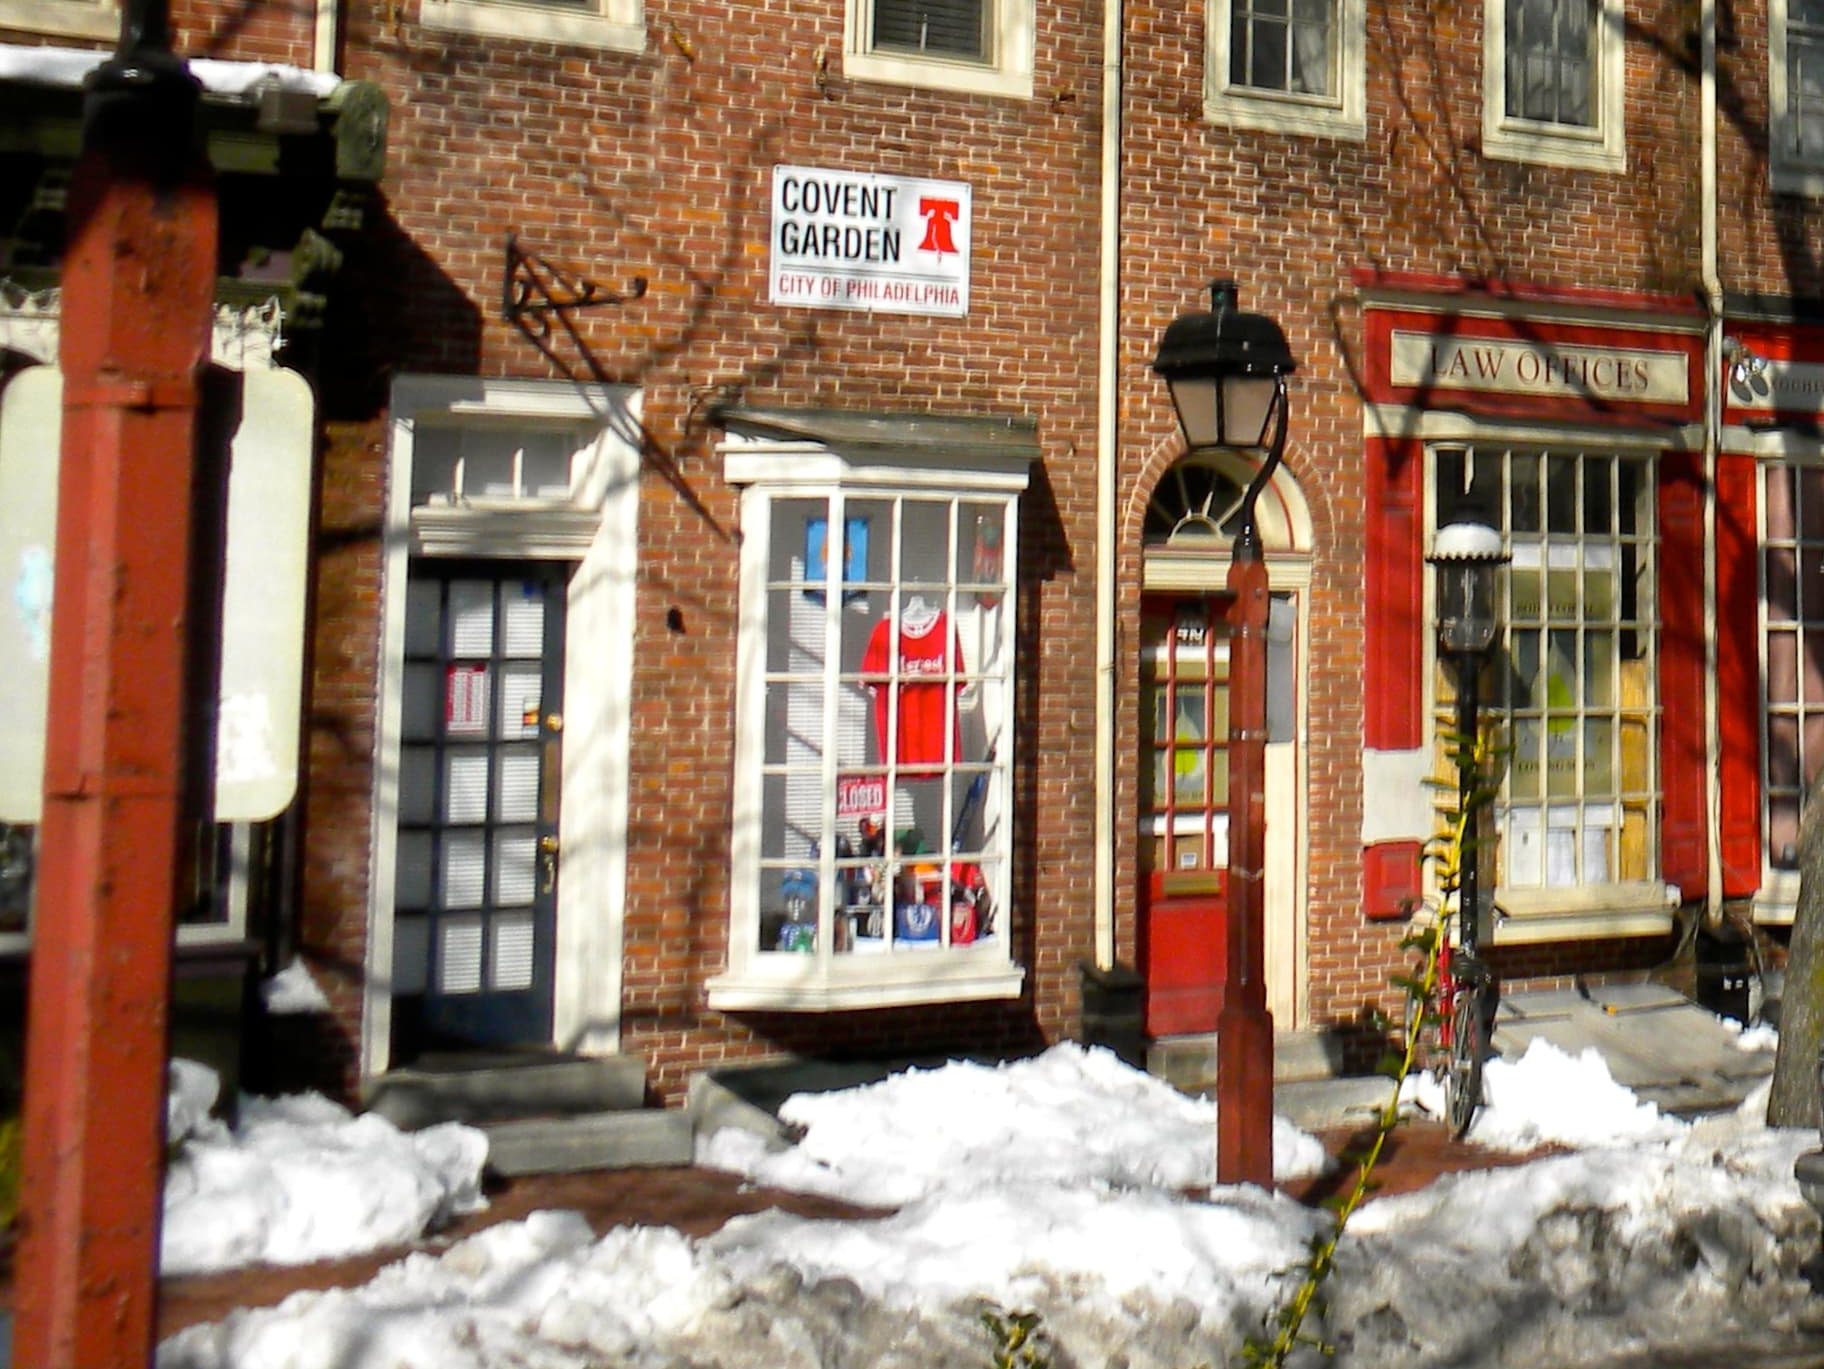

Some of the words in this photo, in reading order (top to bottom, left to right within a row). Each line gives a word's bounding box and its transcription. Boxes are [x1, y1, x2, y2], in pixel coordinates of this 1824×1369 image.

[782, 176, 898, 220] COVENT
[780, 221, 900, 263] GARDEN
[779, 275, 815, 297] CITY
[821, 278, 841, 298] OF
[846, 280, 960, 305] PHILADELPHIA
[1431, 344, 1505, 380] LAW
[1516, 350, 1649, 393] OFFICES
